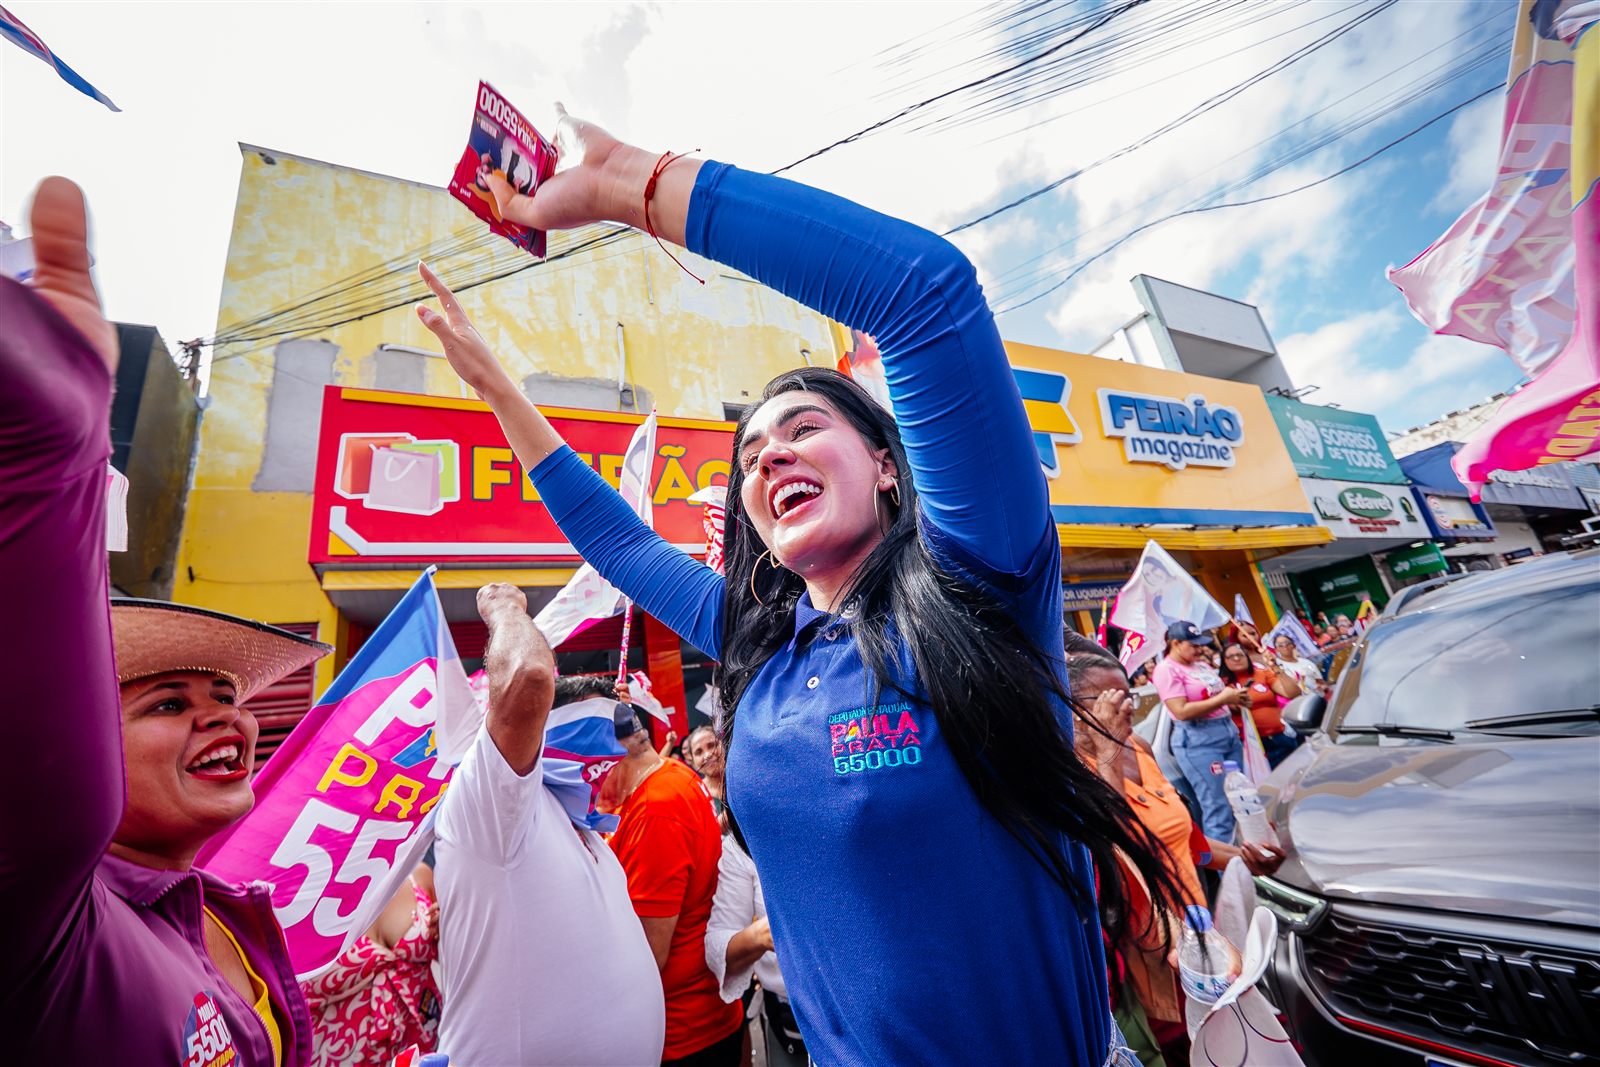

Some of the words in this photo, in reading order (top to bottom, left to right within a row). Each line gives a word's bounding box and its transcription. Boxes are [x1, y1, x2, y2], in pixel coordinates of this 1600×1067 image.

[480, 87, 518, 137] 55000
[1108, 394, 1242, 441] FEIRÃO
[1131, 436, 1231, 463] magazine
[1320, 427, 1379, 451] SORRISO
[1327, 446, 1344, 460] DE
[1341, 447, 1388, 470] TODOS
[828, 706, 866, 724] DEPUTADA
[867, 702, 912, 716] ESTADUAL
[829, 711, 920, 744] PAULA
[831, 733, 922, 757] PRATA
[833, 746, 922, 776] 55000
[1458, 948, 1600, 1042] FIAT
